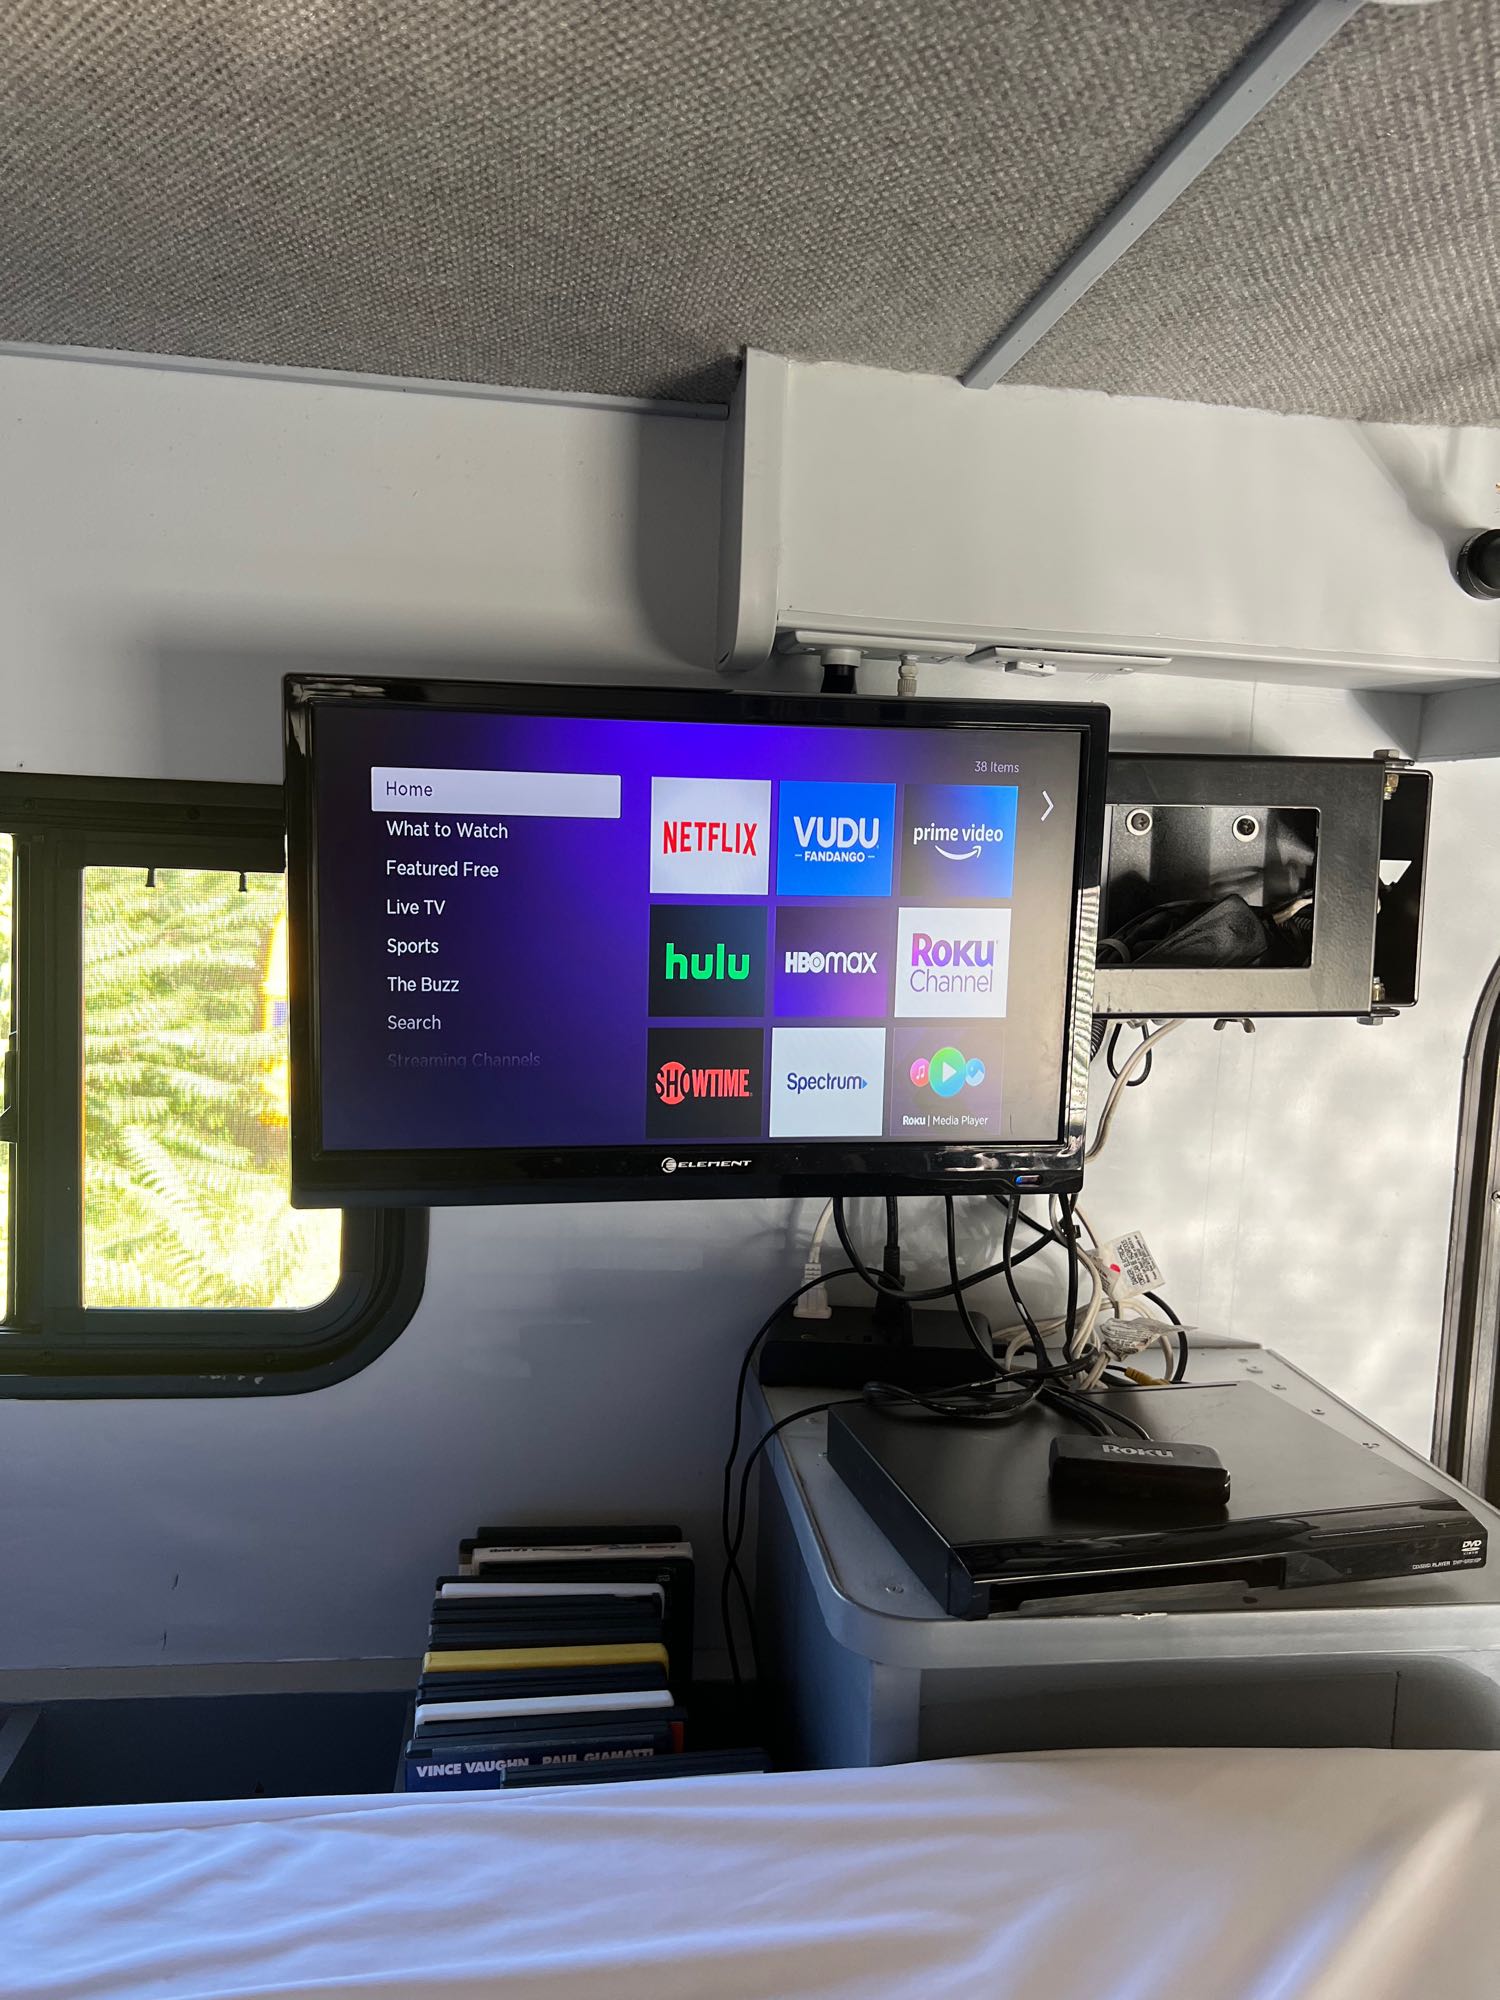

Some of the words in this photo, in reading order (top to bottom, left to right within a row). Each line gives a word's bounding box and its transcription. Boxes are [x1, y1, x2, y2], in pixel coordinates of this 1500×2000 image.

[974, 760, 988, 773] 38
[990, 760, 1020, 774] Items
[386, 781, 433, 797] Home
[386, 820, 430, 838] What
[434, 821, 452, 838] to
[456, 822, 509, 840] Watch
[662, 820, 758, 857] NETFLIX
[793, 816, 879, 849] VUDU
[913, 823, 959, 845] prime
[962, 823, 1004, 843] video
[804, 850, 866, 864] FANDANGO
[386, 860, 458, 877] Featured
[463, 861, 499, 878] Free
[386, 899, 420, 915] Live
[424, 900, 446, 915] TV
[386, 937, 440, 956] Sports
[665, 942, 750, 980] hulu
[387, 976, 417, 992] The
[421, 976, 460, 993] Buzz
[910, 968, 993, 993] Channel
[387, 1014, 442, 1030] Search
[387, 1053, 467, 1069] Streaming
[472, 1052, 541, 1067] Channels
[656, 1061, 750, 1105] SHOWTIME
[787, 1071, 863, 1095] Spectrum
[933, 1115, 959, 1126] Media
[961, 1115, 989, 1128] Player
[677, 1158, 752, 1169] ELEMENT
[1462, 1540, 1482, 1548] DVD
[1432, 1560, 1451, 1568] PLAYER
[416, 1762, 461, 1778] VINCE
[465, 1757, 530, 1774] VAUGHN
